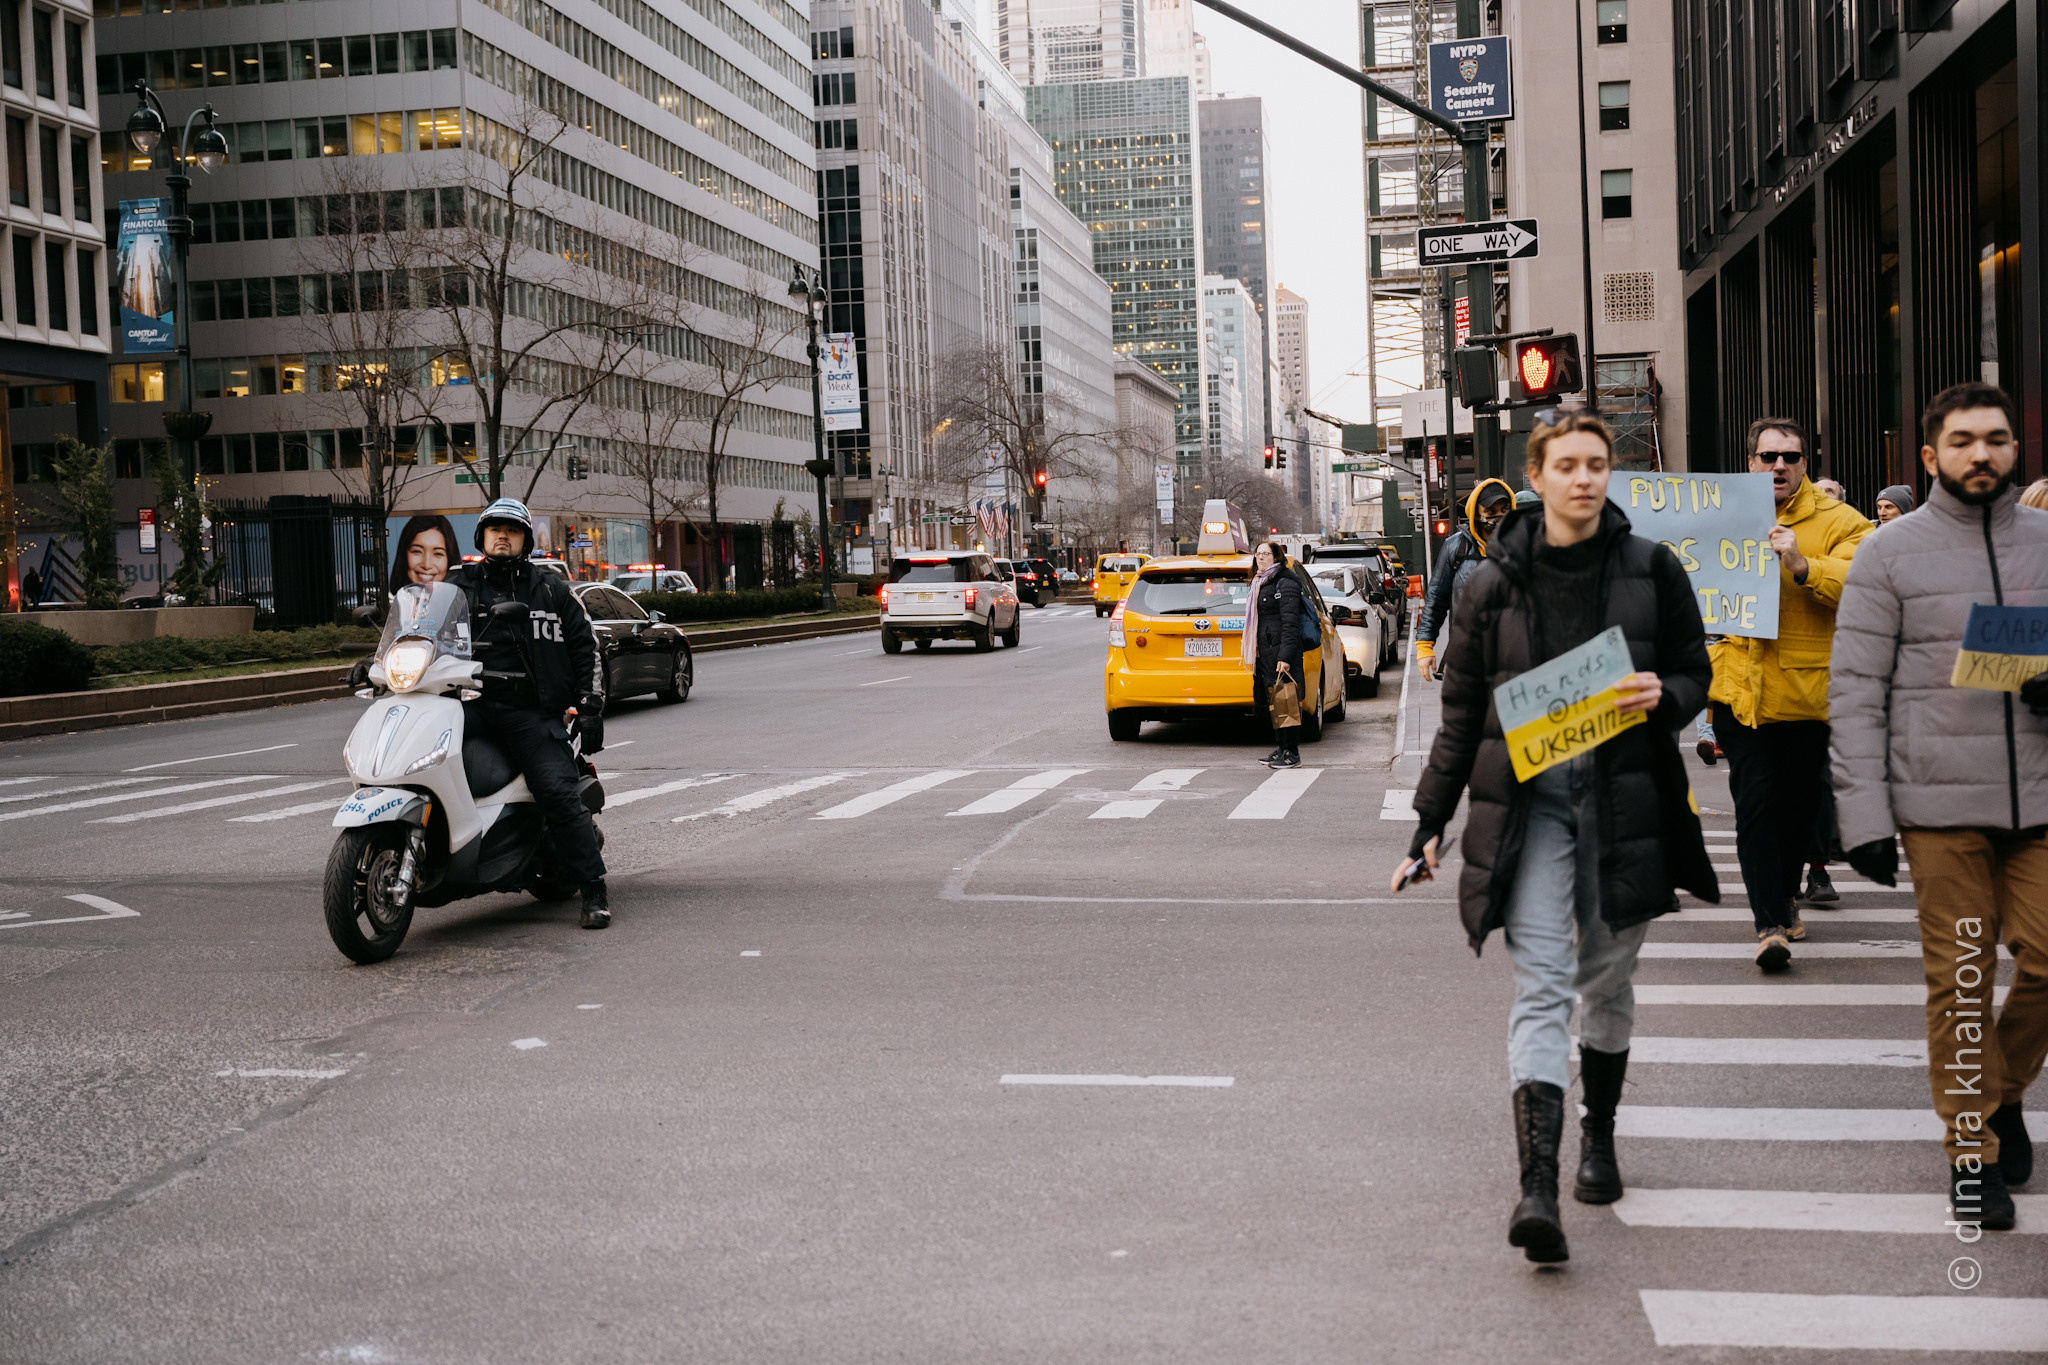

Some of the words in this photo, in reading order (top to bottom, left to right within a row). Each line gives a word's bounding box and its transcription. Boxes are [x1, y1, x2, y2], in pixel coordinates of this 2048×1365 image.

[1450, 44, 1486, 58] NYPD
[1444, 82, 1495, 97] Security
[1445, 97, 1494, 110] Camera
[122, 219, 168, 230] FINANCIAL
[1429, 237, 1463, 253] ONE
[1483, 231, 1522, 249] WAY
[128, 329, 158, 337] CANTOR
[137, 333, 169, 345] Fitzgerald
[827, 373, 854, 381] DCAT
[826, 381, 856, 391] Week
[1417, 400, 1438, 413] THE
[1344, 464, 1349, 472] E
[1630, 476, 1721, 514] PUTIN
[1719, 537, 1774, 577] OFF
[1508, 653, 1605, 711] Hands
[1547, 686, 1590, 724] Off
[367, 798, 403, 822] POLICE
